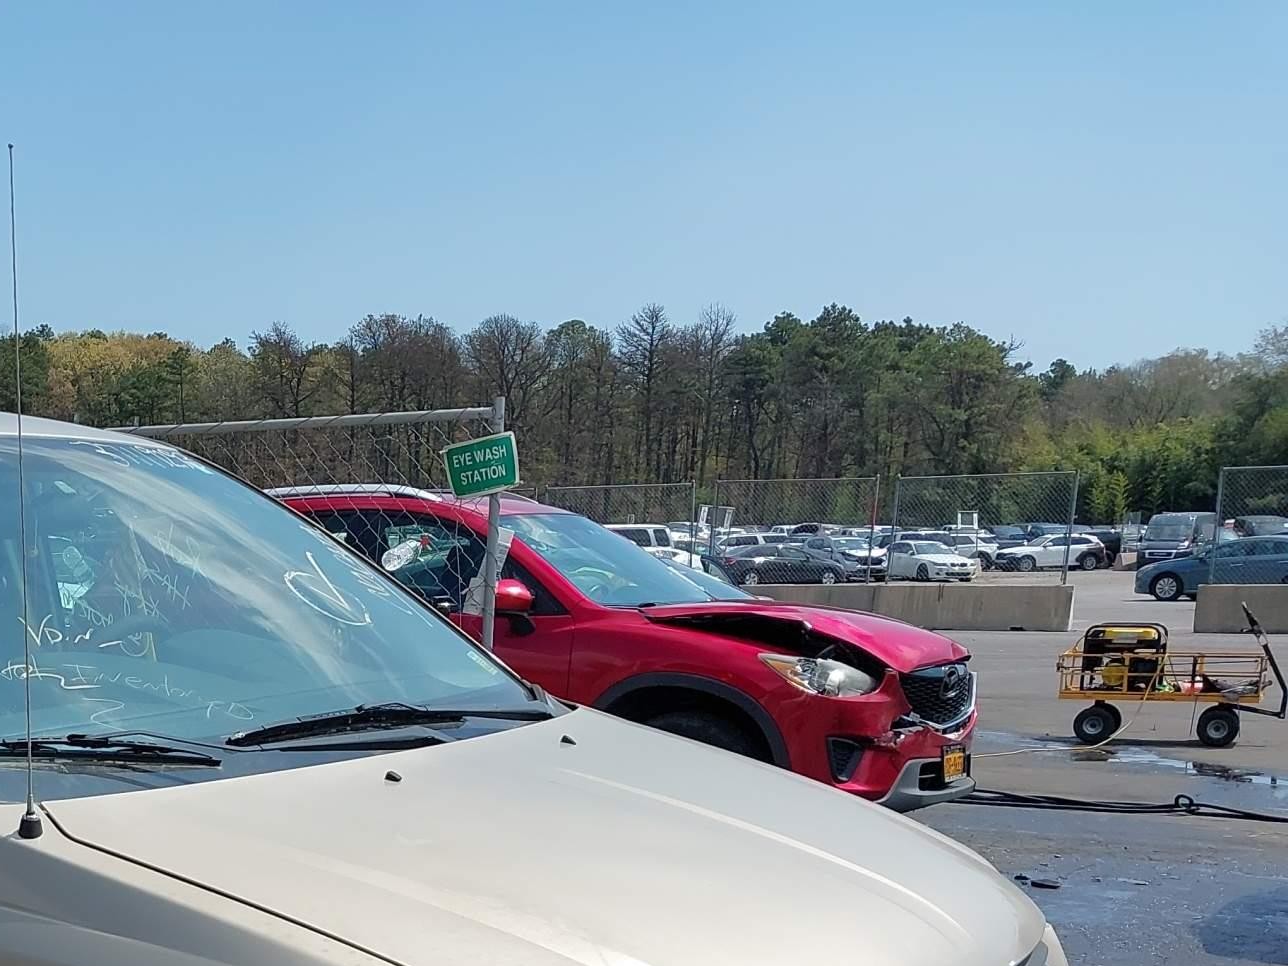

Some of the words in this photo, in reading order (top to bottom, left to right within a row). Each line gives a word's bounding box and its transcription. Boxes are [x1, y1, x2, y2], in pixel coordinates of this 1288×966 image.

[452, 452, 473, 468] EYE
[473, 444, 507, 463] WASH
[460, 463, 506, 485] STATION
